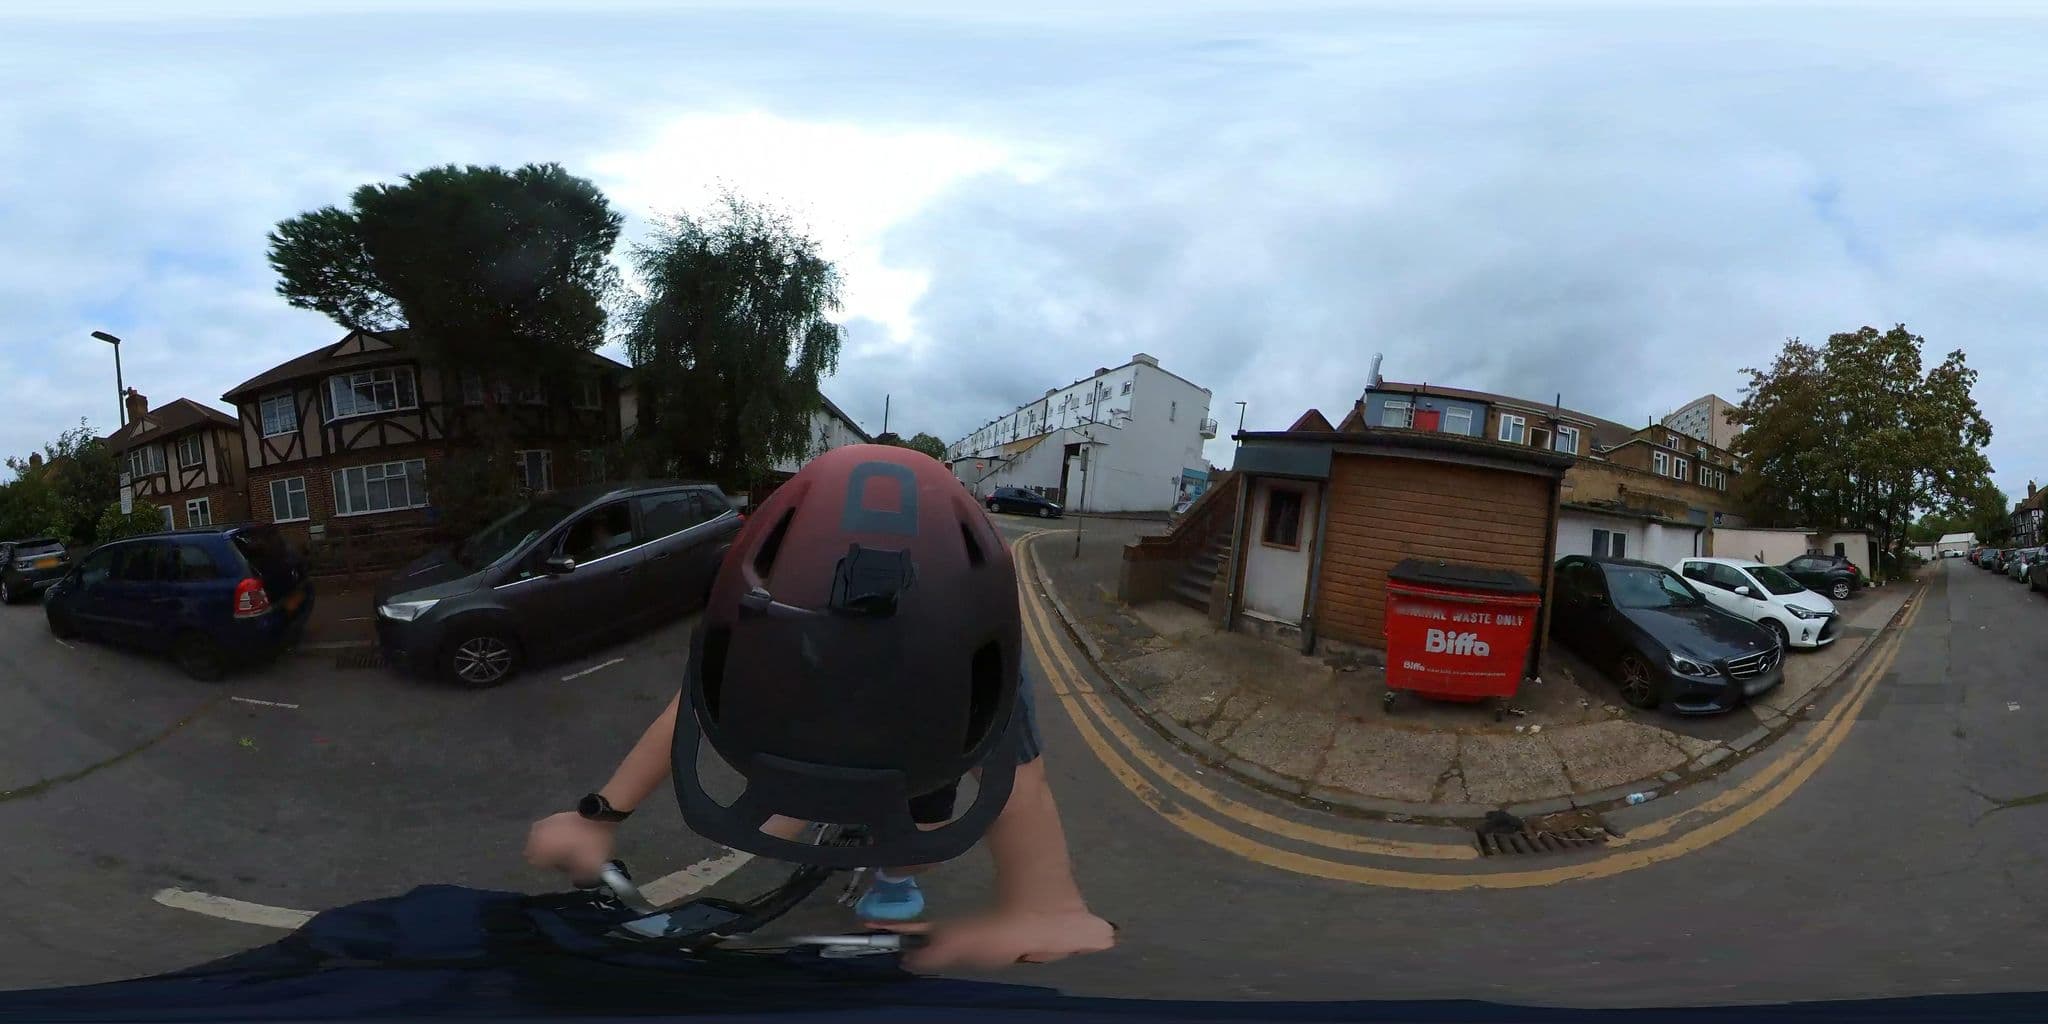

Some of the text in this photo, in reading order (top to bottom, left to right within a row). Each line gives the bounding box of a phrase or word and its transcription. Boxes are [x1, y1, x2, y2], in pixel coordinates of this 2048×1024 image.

[1453, 610, 1491, 624] WASTE
[1495, 613, 1524, 627] ONLY
[1425, 628, 1490, 657] Biffa
[1403, 660, 1425, 672] Biffa
